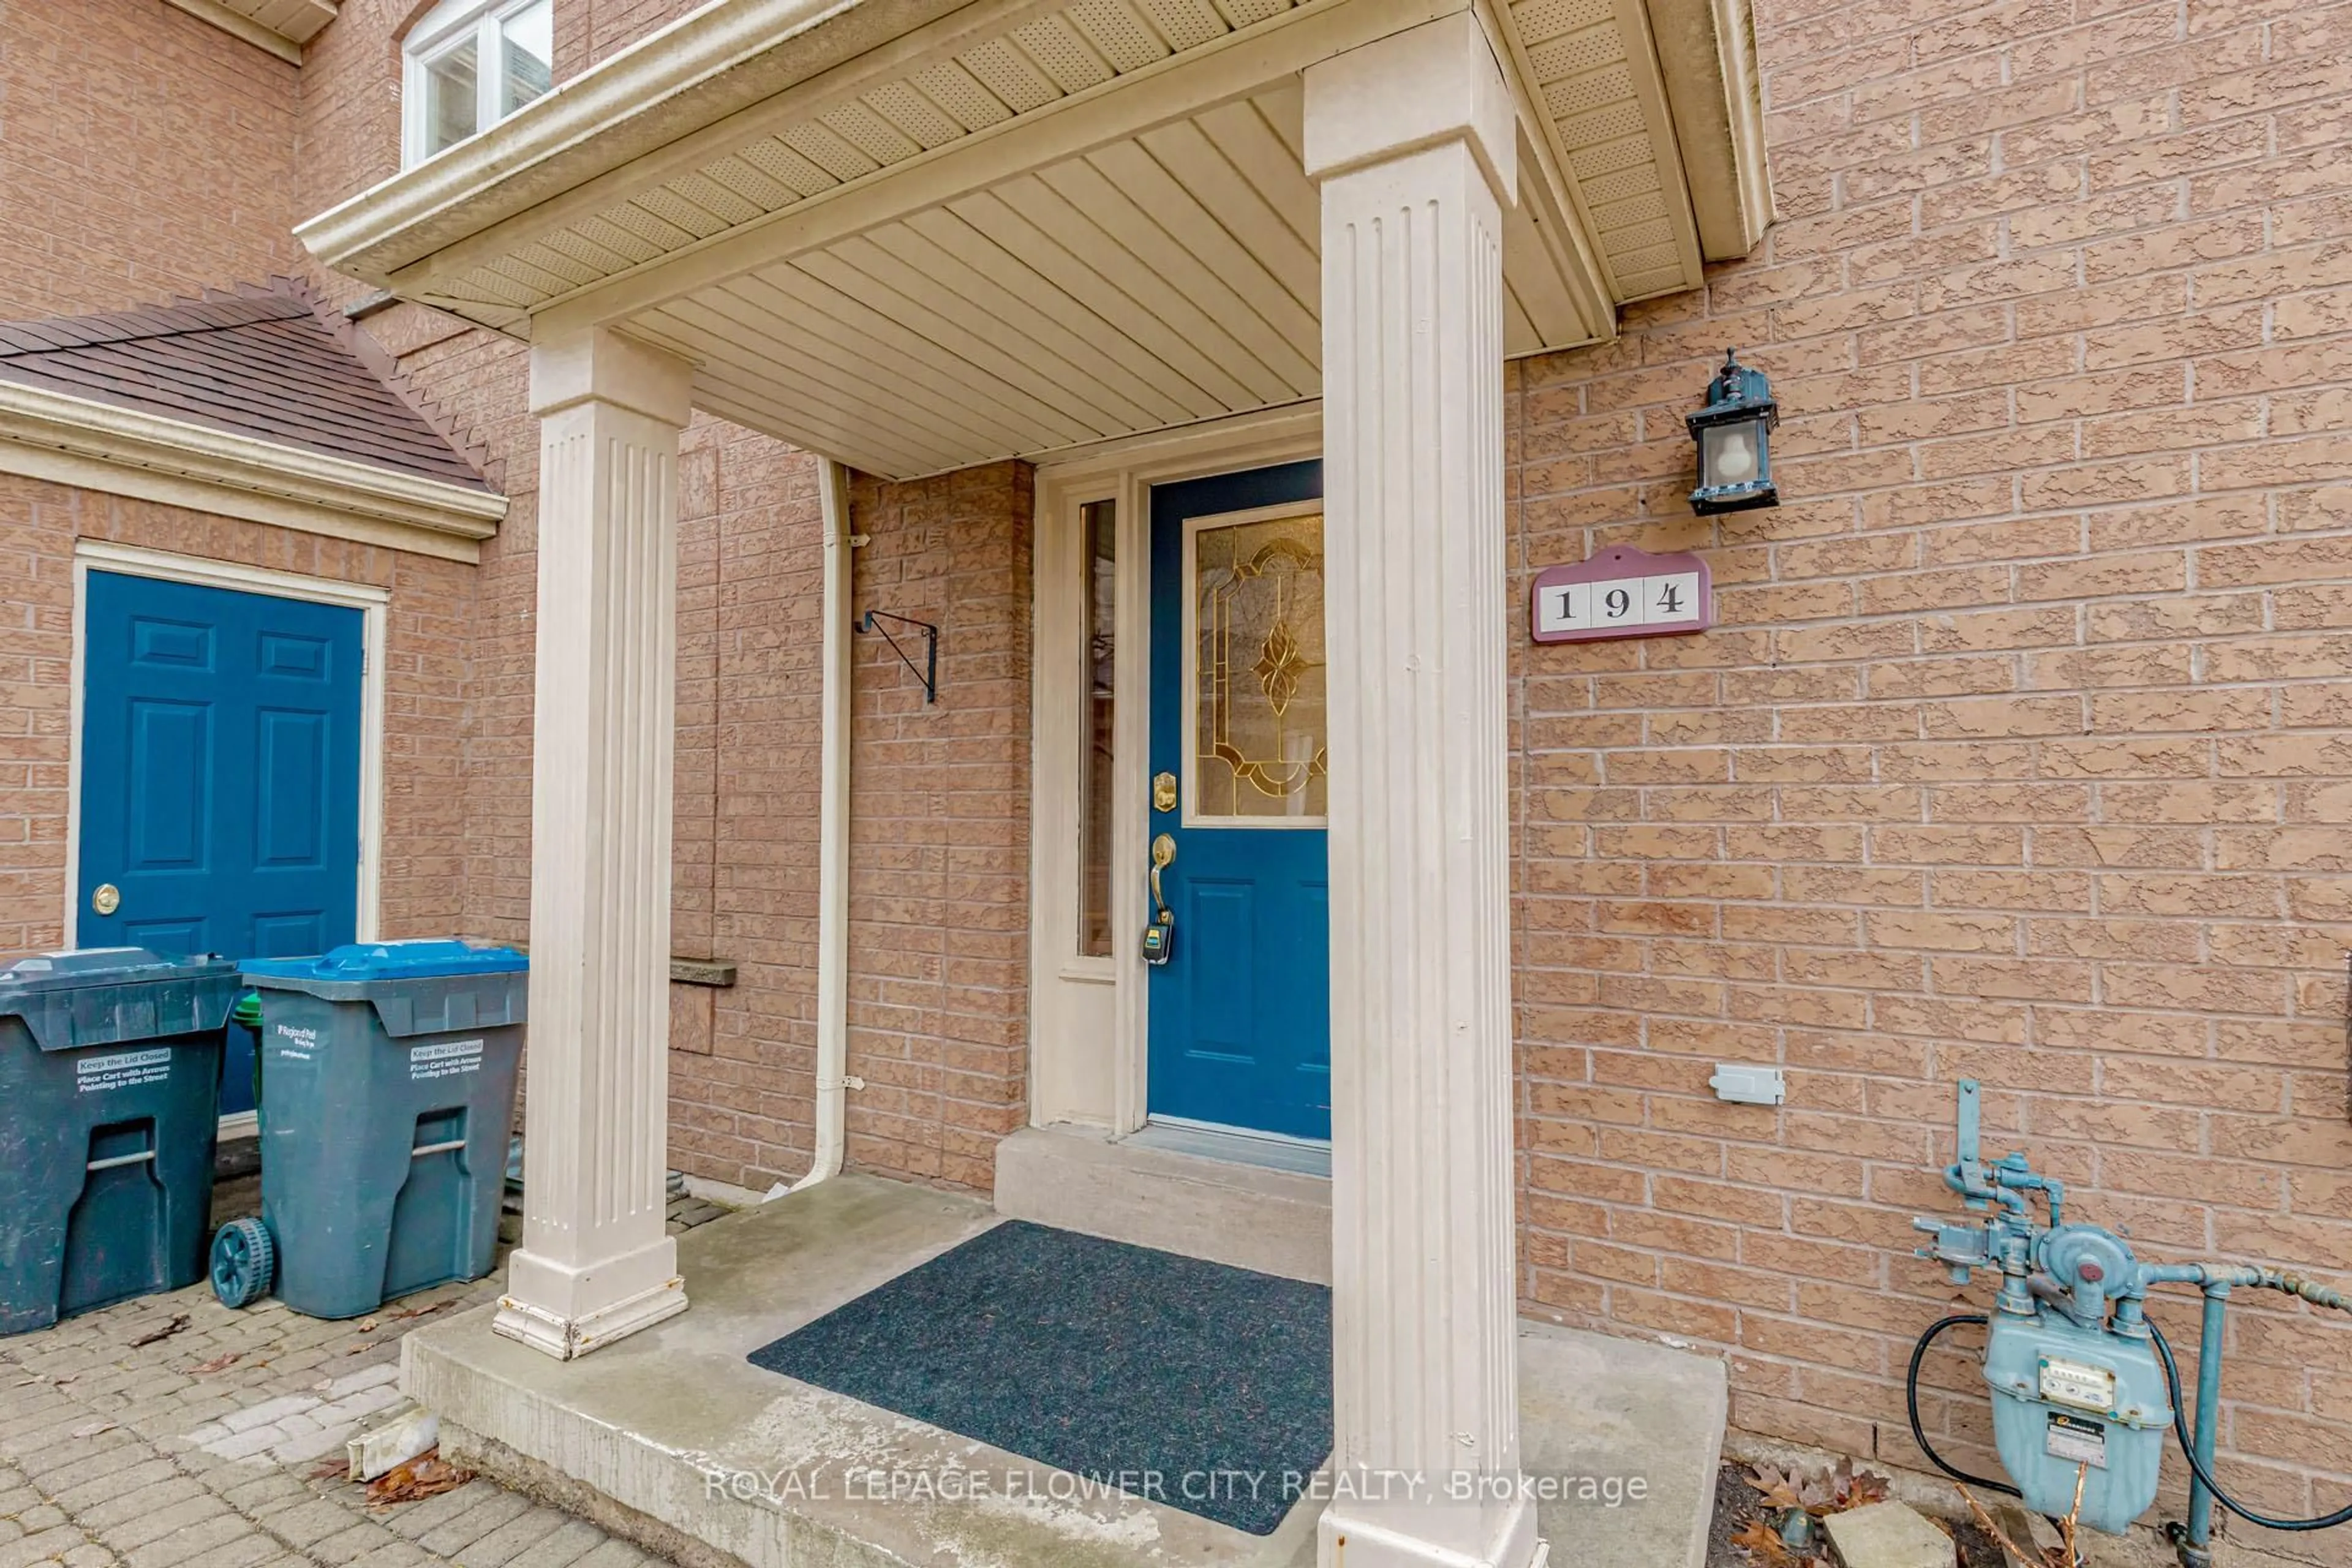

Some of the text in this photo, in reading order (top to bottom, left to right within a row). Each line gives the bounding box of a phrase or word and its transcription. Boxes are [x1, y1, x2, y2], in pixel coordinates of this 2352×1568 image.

[1556, 582, 1684, 619] 194
[80, 1051, 169, 1070] Keep the Lid Closed
[77, 1066, 170, 1084] Place Cart with Arrows
[79, 1082, 116, 1092] Pointing
[129, 1076, 142, 1085] the
[143, 1073, 168, 1082] Street
